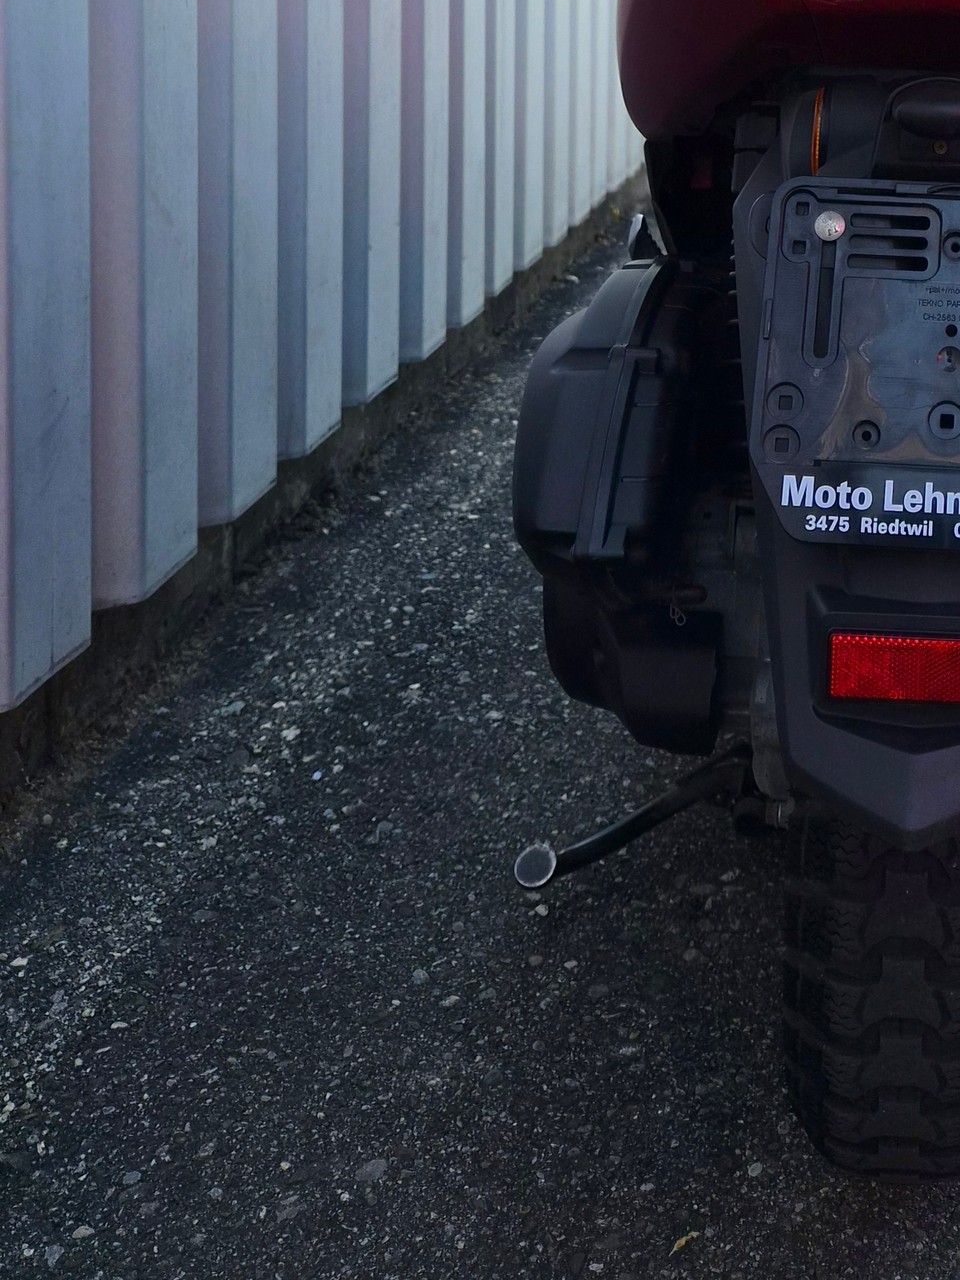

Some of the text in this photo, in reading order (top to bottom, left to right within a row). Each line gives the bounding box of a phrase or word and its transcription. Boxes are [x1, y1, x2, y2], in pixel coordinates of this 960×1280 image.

[918, 299, 944, 308] TEKNO
[922, 312, 957, 322] CH-2563
[781, 475, 873, 511] Moto
[804, 514, 850, 532] 3475
[860, 517, 934, 537] Riedtwil
